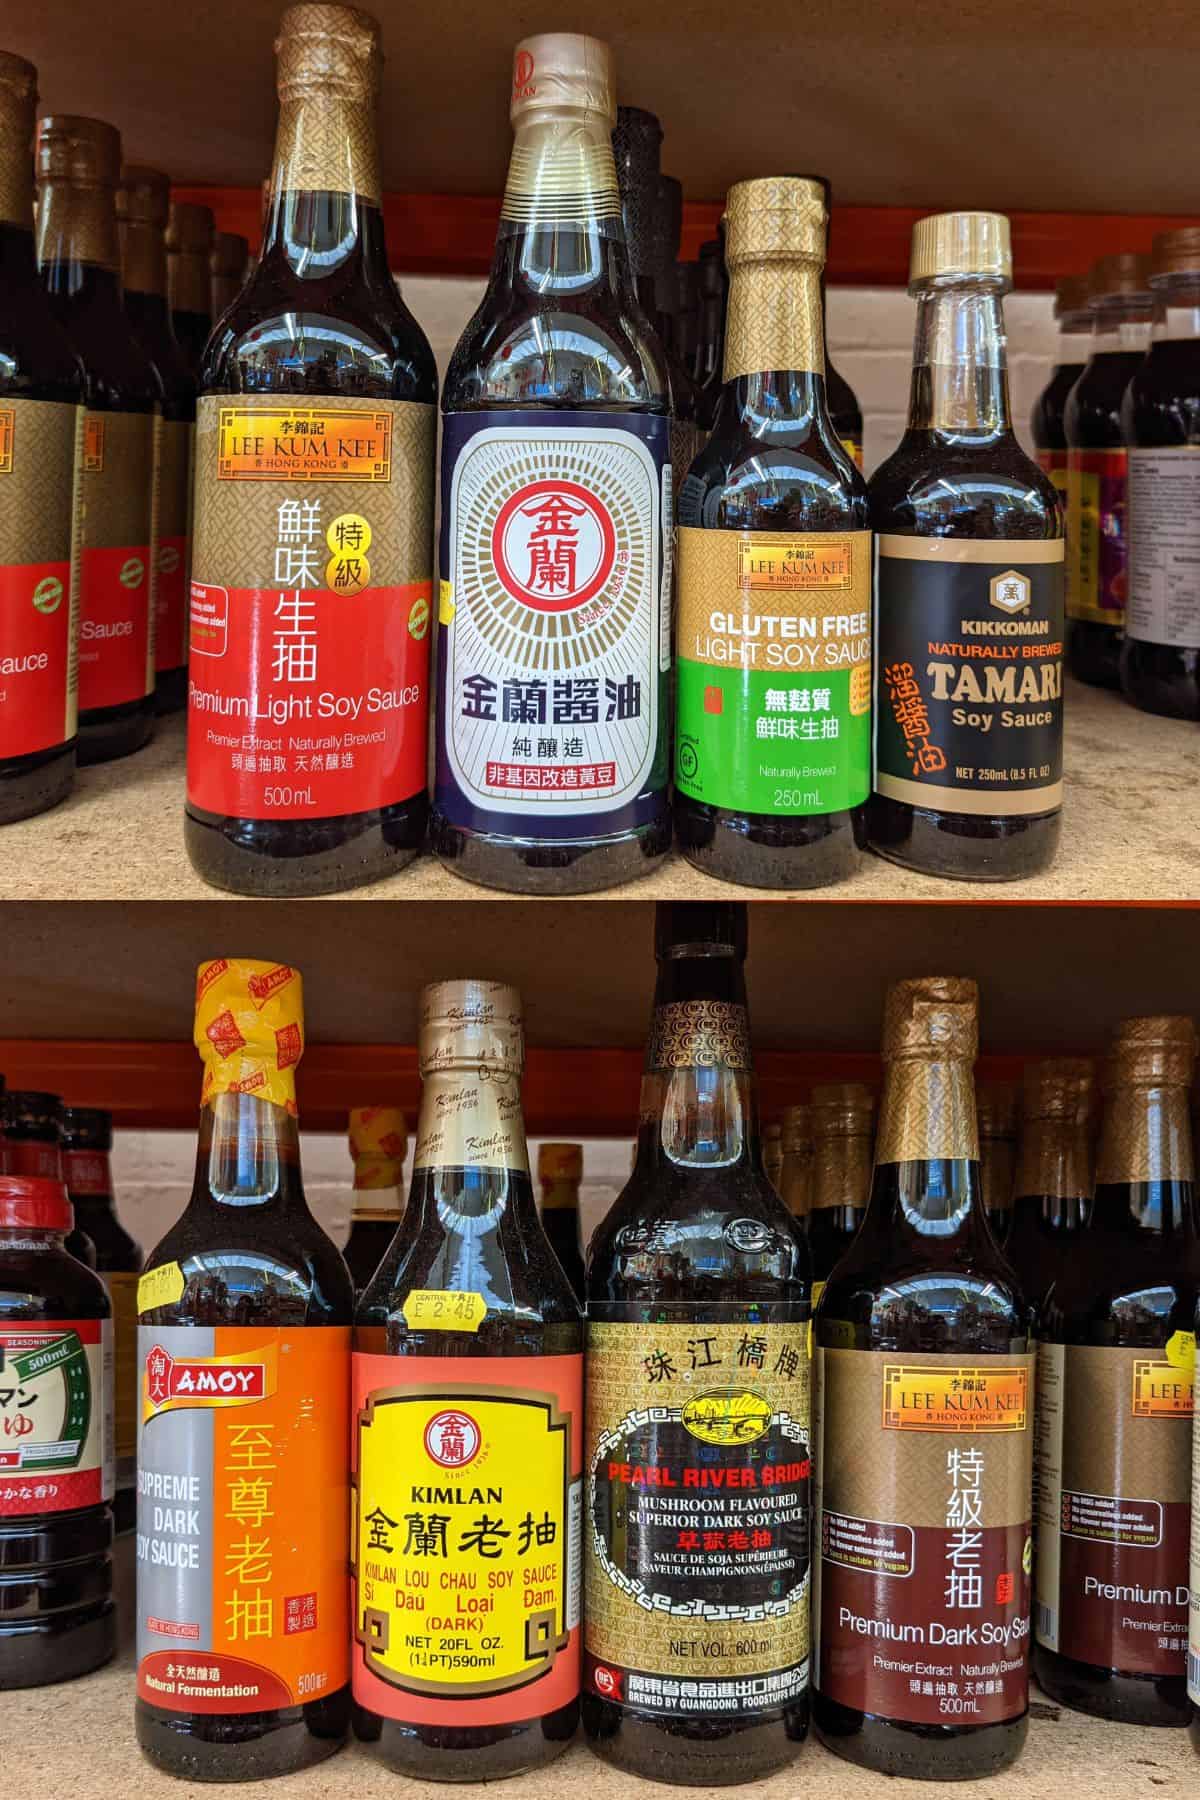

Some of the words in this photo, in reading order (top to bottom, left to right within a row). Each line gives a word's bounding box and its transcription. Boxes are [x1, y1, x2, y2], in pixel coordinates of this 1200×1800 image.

[280, 421, 325, 435] 李錦記
[232, 437, 264, 456] LEE
[273, 438, 329, 457] KUM
[337, 439, 377, 458] KEE
[266, 459, 300, 469] HONG
[303, 460, 337, 470] KONG
[332, 520, 365, 588] 特級
[520, 495, 587, 594] 金蘭
[750, 560, 776, 574] LEE
[782, 561, 817, 575] KUM
[822, 561, 845, 574] KEE
[272, 498, 322, 683] 鮮味生抽
[81, 621, 133, 640] Sauce
[710, 612, 817, 639] GLUTEN
[822, 612, 868, 638] FREE
[961, 620, 1049, 636] KIKKOMAN
[696, 635, 762, 665] LIGHT
[766, 643, 821, 666] SOY
[825, 637, 872, 665] SAUC
[928, 642, 1019, 659] NATURALLY
[188, 681, 249, 717] Premium
[255, 693, 312, 726] Light
[317, 692, 364, 721] Soy
[367, 684, 420, 713] Sauce
[462, 673, 641, 725] 金蘭醬油
[756, 715, 840, 740] 鮮味生抽
[953, 708, 993, 732] Soy
[1001, 710, 1053, 728] Sauce
[207, 729, 241, 748] Premier
[241, 735, 283, 751] Extract
[289, 735, 343, 751] Naturally
[343, 728, 387, 747] Brewed
[512, 736, 584, 759] 純釀造
[489, 766, 614, 787] 非基因改造黃豆
[759, 764, 802, 780] Naturally
[802, 764, 838, 777] Brewed
[956, 767, 974, 779] NET
[978, 768, 1009, 781] 250mL
[1029, 769, 1037, 779] FL
[465, 1132, 512, 1151] Kimlan
[7, 1338, 53, 1347] SEASONIN
[28, 1343, 70, 1372] 500ml
[640, 1332, 800, 1383] 珠江橋牌
[151, 1354, 165, 1398] 淘大
[176, 1370, 255, 1393] AMOY
[950, 1379, 987, 1392] 李錦記
[900, 1391, 936, 1409] LEE
[944, 1393, 990, 1411] KUM
[993, 1393, 1020, 1409] KEE
[1151, 1383, 1183, 1399] LEE
[935, 1411, 967, 1421] HONG
[438, 1415, 469, 1461] 金蘭
[608, 1462, 677, 1488] PEARL
[683, 1468, 757, 1489] RIVER
[411, 1486, 503, 1505] KIMLAN
[638, 1495, 726, 1512] MUSHROOM
[729, 1493, 798, 1512] FLAVOURED
[154, 1506, 201, 1536] DARK
[629, 1510, 700, 1528] SUPERIOR
[703, 1514, 743, 1528] DARK
[746, 1512, 772, 1527] SOY
[773, 1507, 803, 1526] SAUCE
[944, 1447, 985, 1609] 特級老抽
[224, 1424, 277, 1641] 至尊老抽
[365, 1506, 557, 1559] 金蘭老抽
[151, 1538, 200, 1569] SAUCE
[653, 1551, 687, 1565] SAUCE
[690, 1553, 705, 1564] DE
[707, 1554, 733, 1566] SOJA
[365, 1561, 397, 1585] KIMLAN
[405, 1569, 430, 1589] LOU
[440, 1571, 477, 1590] CHAU
[488, 1570, 514, 1589] SOY
[523, 1562, 558, 1586] SAUCE
[643, 1563, 682, 1576] SAVEUR
[1085, 1576, 1172, 1606] Premium
[426, 1616, 484, 1634] (DARK)
[839, 1607, 924, 1644] Premium
[929, 1622, 978, 1646] Dark
[980, 1622, 1012, 1647] Soy
[1122, 1617, 1161, 1633] Premier
[405, 1635, 433, 1649] NET
[440, 1637, 473, 1651] 20FL
[480, 1636, 505, 1650] OZ.
[669, 1640, 697, 1657] NET
[873, 1655, 914, 1674] Premier
[914, 1662, 953, 1677] Extract
[960, 1663, 1000, 1677] Naturally
[1000, 1656, 1024, 1673] Brewed
[145, 1673, 175, 1693] Natural
[178, 1683, 259, 1697] Fermentation
[628, 1690, 664, 1707] BREWED
[664, 1697, 677, 1707] BY
[679, 1698, 738, 1710] GUANGDONG
[742, 1690, 790, 1707] FOODSTUFFS
